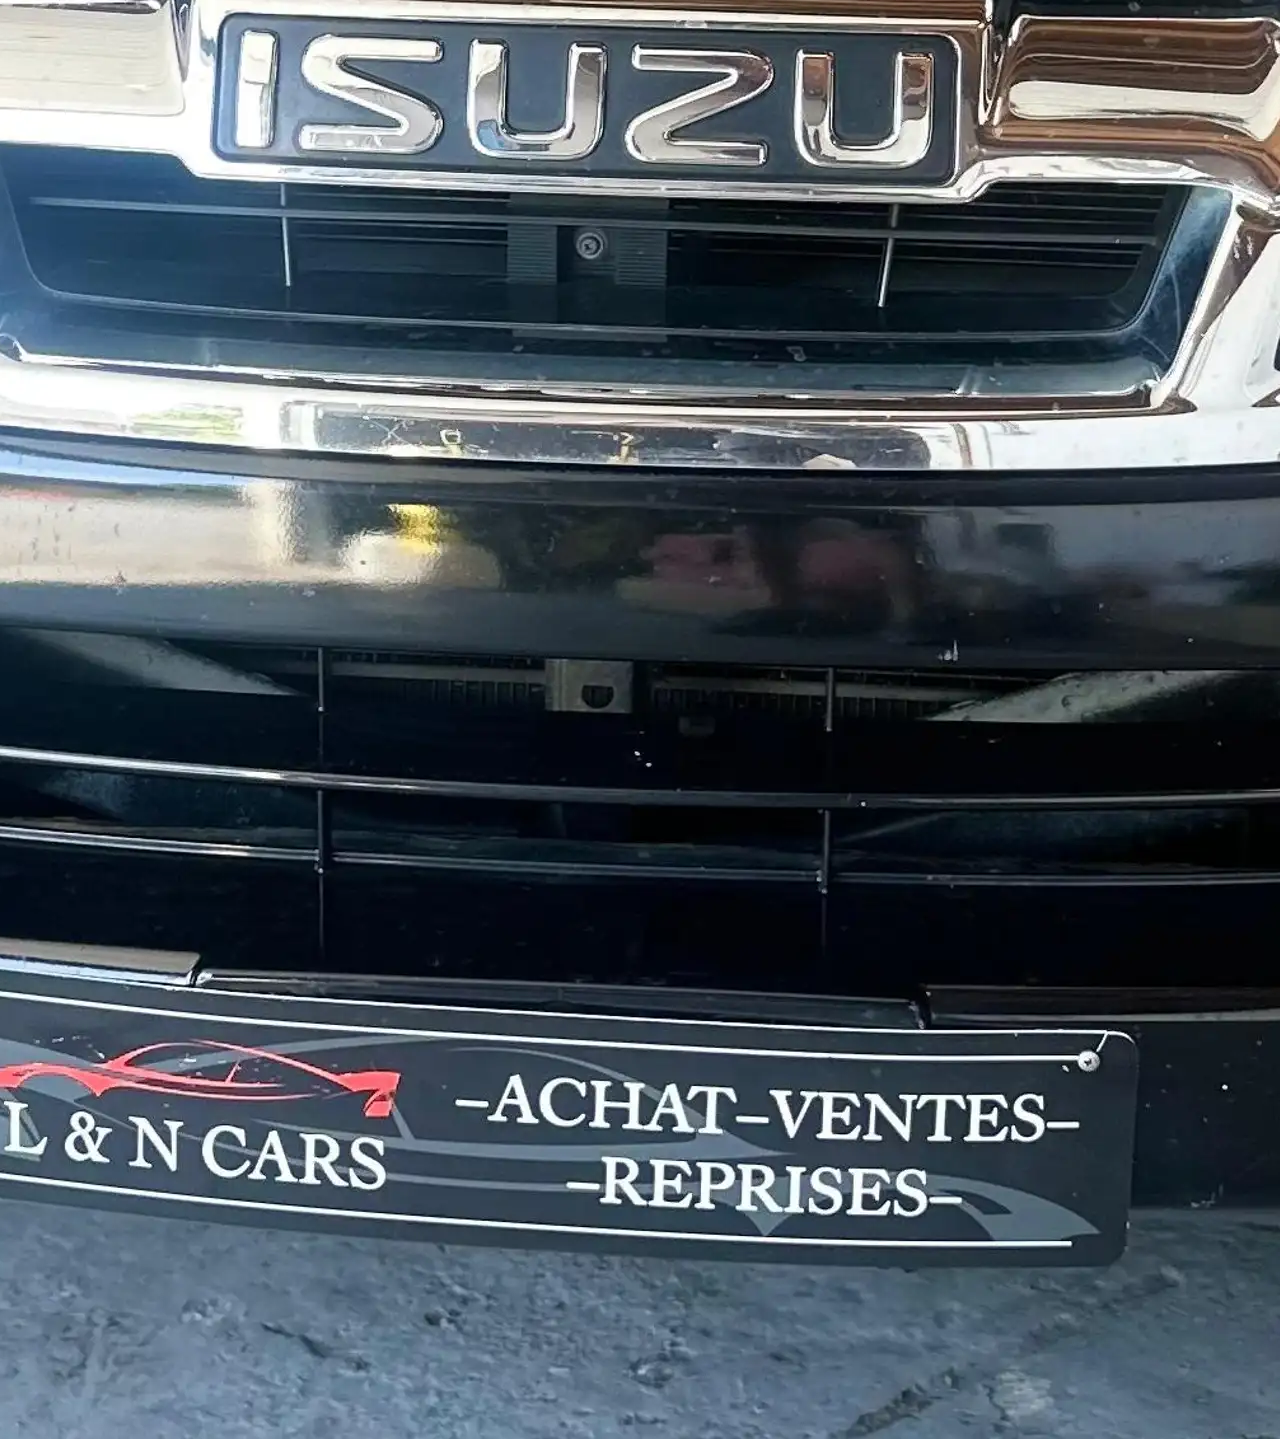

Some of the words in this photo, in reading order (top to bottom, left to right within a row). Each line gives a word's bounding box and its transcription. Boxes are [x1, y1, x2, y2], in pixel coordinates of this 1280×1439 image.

[237, 30, 936, 168] ISUZU
[3, 1100, 48, 1155] L
[64, 1111, 113, 1163] &
[128, 1115, 185, 1172] N
[201, 1124, 388, 1191] CARS
